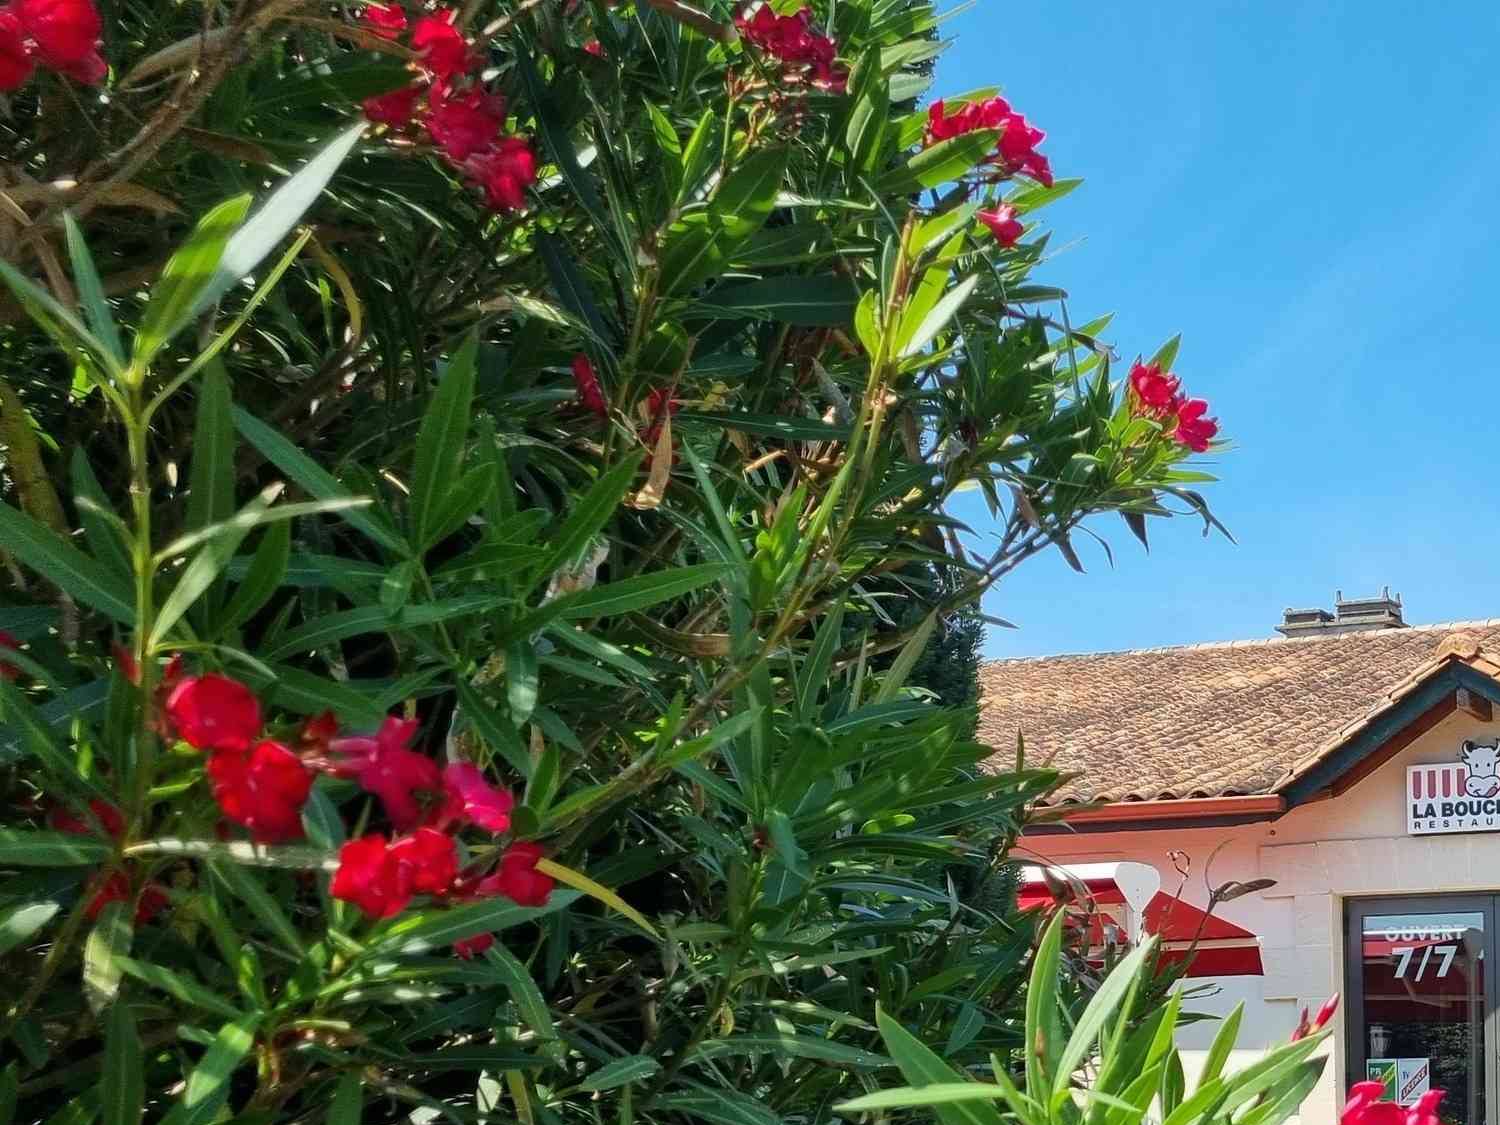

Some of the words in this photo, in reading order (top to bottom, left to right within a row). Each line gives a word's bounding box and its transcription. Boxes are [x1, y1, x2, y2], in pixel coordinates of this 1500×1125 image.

[1412, 802, 1437, 819] LA
[1385, 924, 1465, 942] OUVERT
[1391, 945, 1458, 982] 7/7
